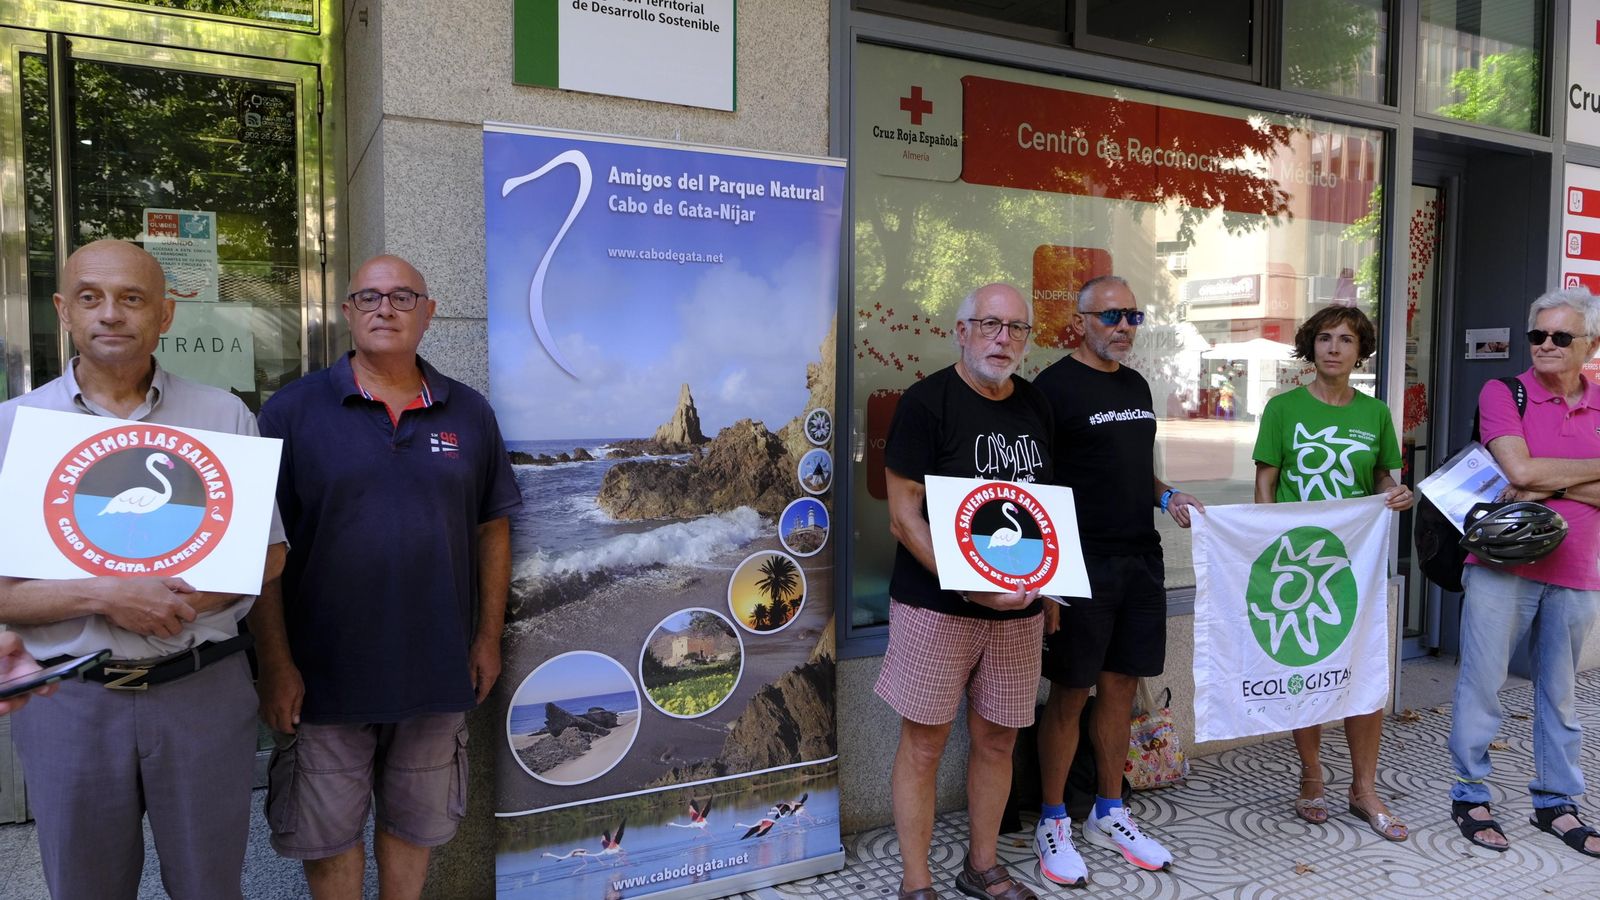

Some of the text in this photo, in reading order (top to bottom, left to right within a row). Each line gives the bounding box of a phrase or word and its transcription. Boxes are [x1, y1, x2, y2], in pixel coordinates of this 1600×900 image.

[572, 0, 720, 32] de Desarrollo Sostenible
[1569, 83, 1600, 114] Cru
[873, 125, 958, 147] Cruz Roja Española
[1017, 122, 1089, 157] Centro
[1096, 135, 1121, 160] de
[1280, 162, 1337, 188] Médico
[608, 166, 825, 202] Amigos del Parque Natural
[608, 195, 756, 225] Cabo de Gata-Níjar
[608, 247, 724, 264] www.cabodegata.net
[160, 337, 242, 352] TRADA
[58, 431, 226, 500] SALVEMOS LAS SALINAS
[959, 487, 1051, 535] SALVEMOS LAS SALINAS
[58, 517, 85, 550] CABO
[82, 549, 105, 565] DE
[969, 550, 990, 572] CABO
[990, 570, 1003, 581] DE
[613, 852, 749, 891] www.cabodegata.net
